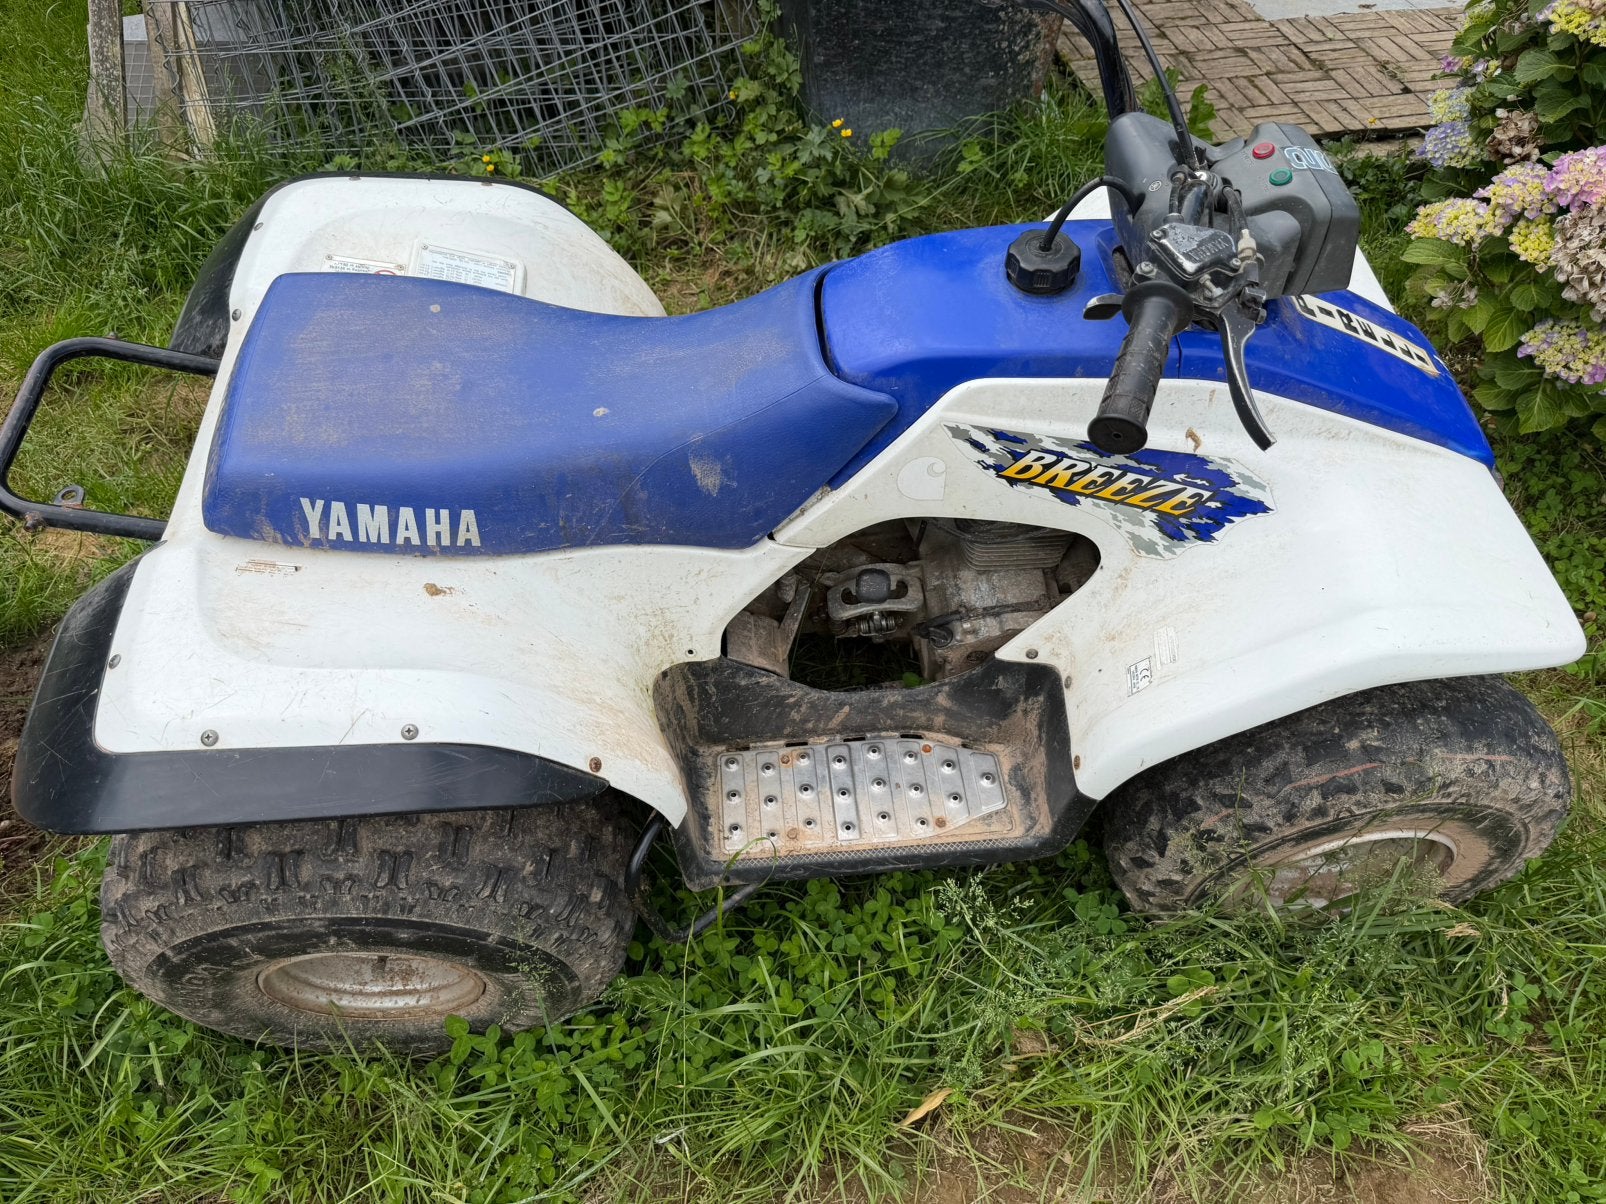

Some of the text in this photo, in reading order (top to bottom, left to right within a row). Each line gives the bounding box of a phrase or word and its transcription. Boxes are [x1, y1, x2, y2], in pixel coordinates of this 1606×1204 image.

[1295, 295, 1430, 366] PIRELLI
[999, 450, 1213, 516] BREEZE
[300, 497, 481, 547] YAMAHA
